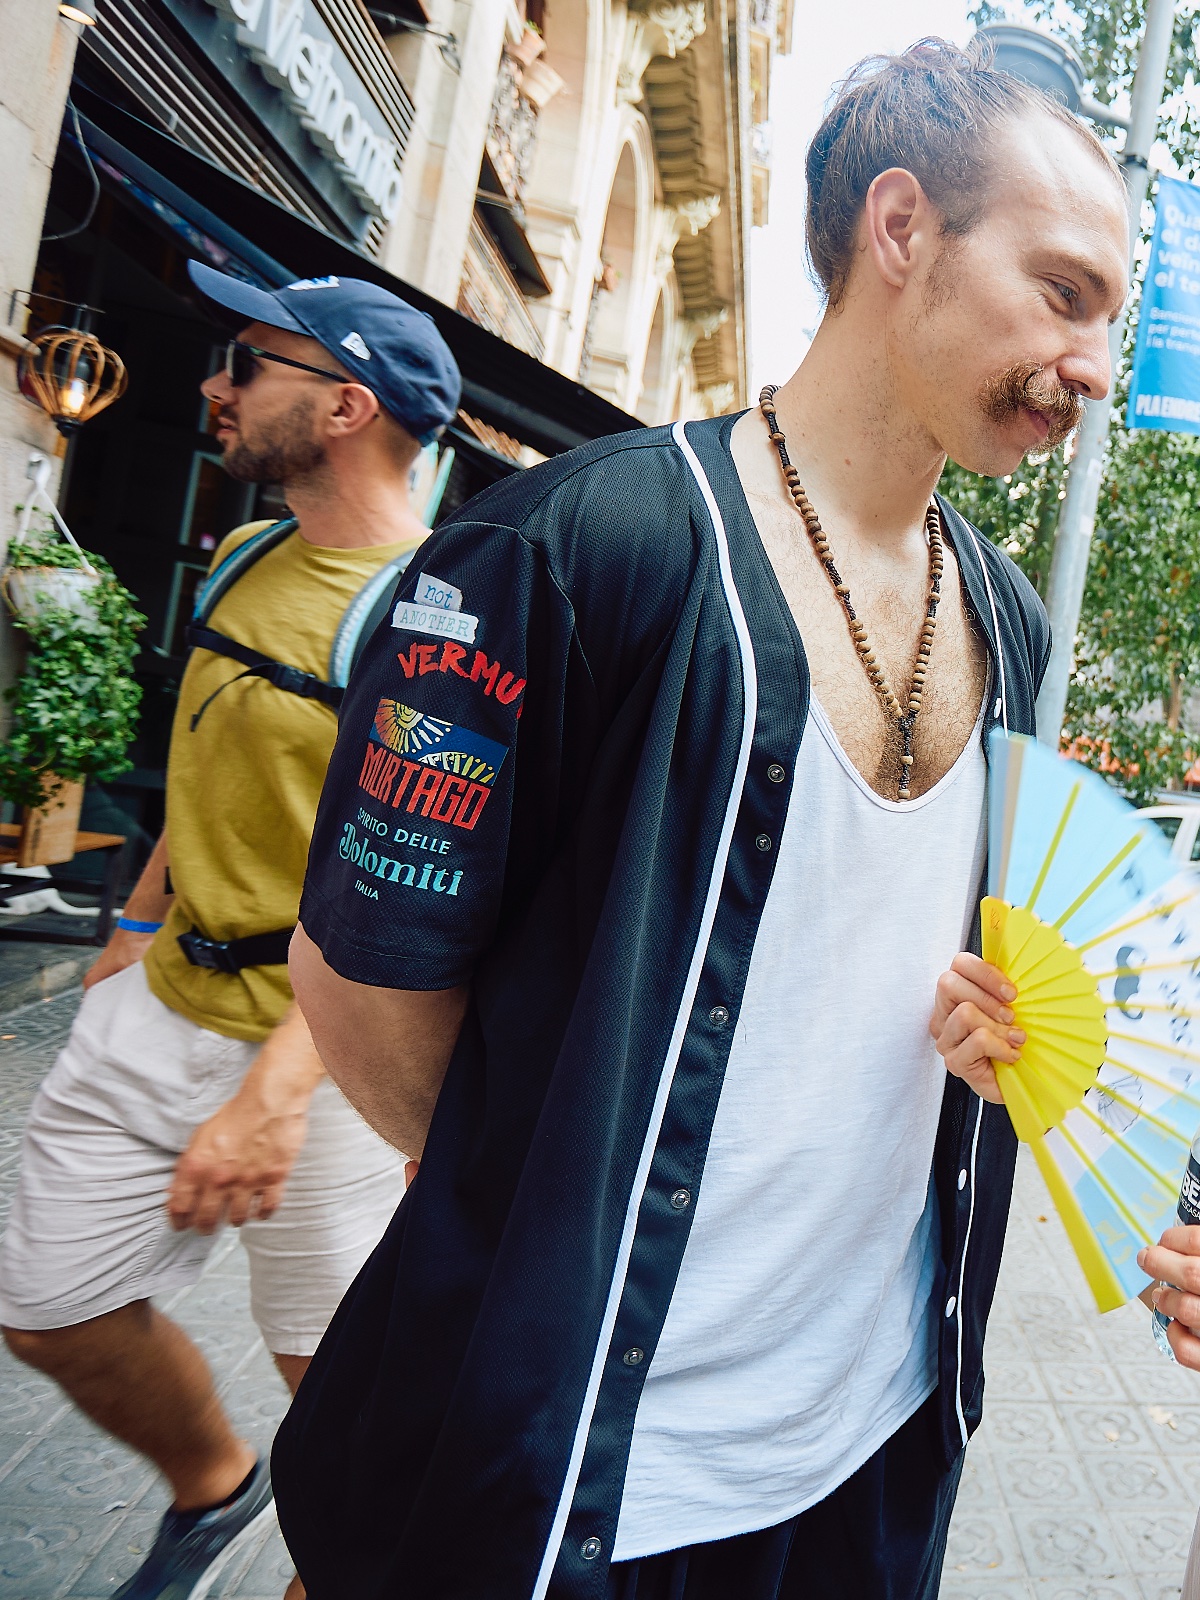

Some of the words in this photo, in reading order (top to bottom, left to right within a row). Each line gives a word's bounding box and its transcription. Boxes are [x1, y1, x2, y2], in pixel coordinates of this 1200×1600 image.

[1161, 228, 1181, 247] el
[1154, 271, 1176, 288] el
[1135, 393, 1161, 417] PLA
[424, 584, 453, 609] not
[400, 608, 470, 637] ANOTHER
[397, 641, 527, 719] VERMU
[359, 742, 491, 830] MURTAGO
[357, 807, 388, 836] SPIRITO
[393, 828, 451, 855] DELLE
[339, 822, 464, 896] Dolomiti
[354, 879, 379, 901] ITALIA
